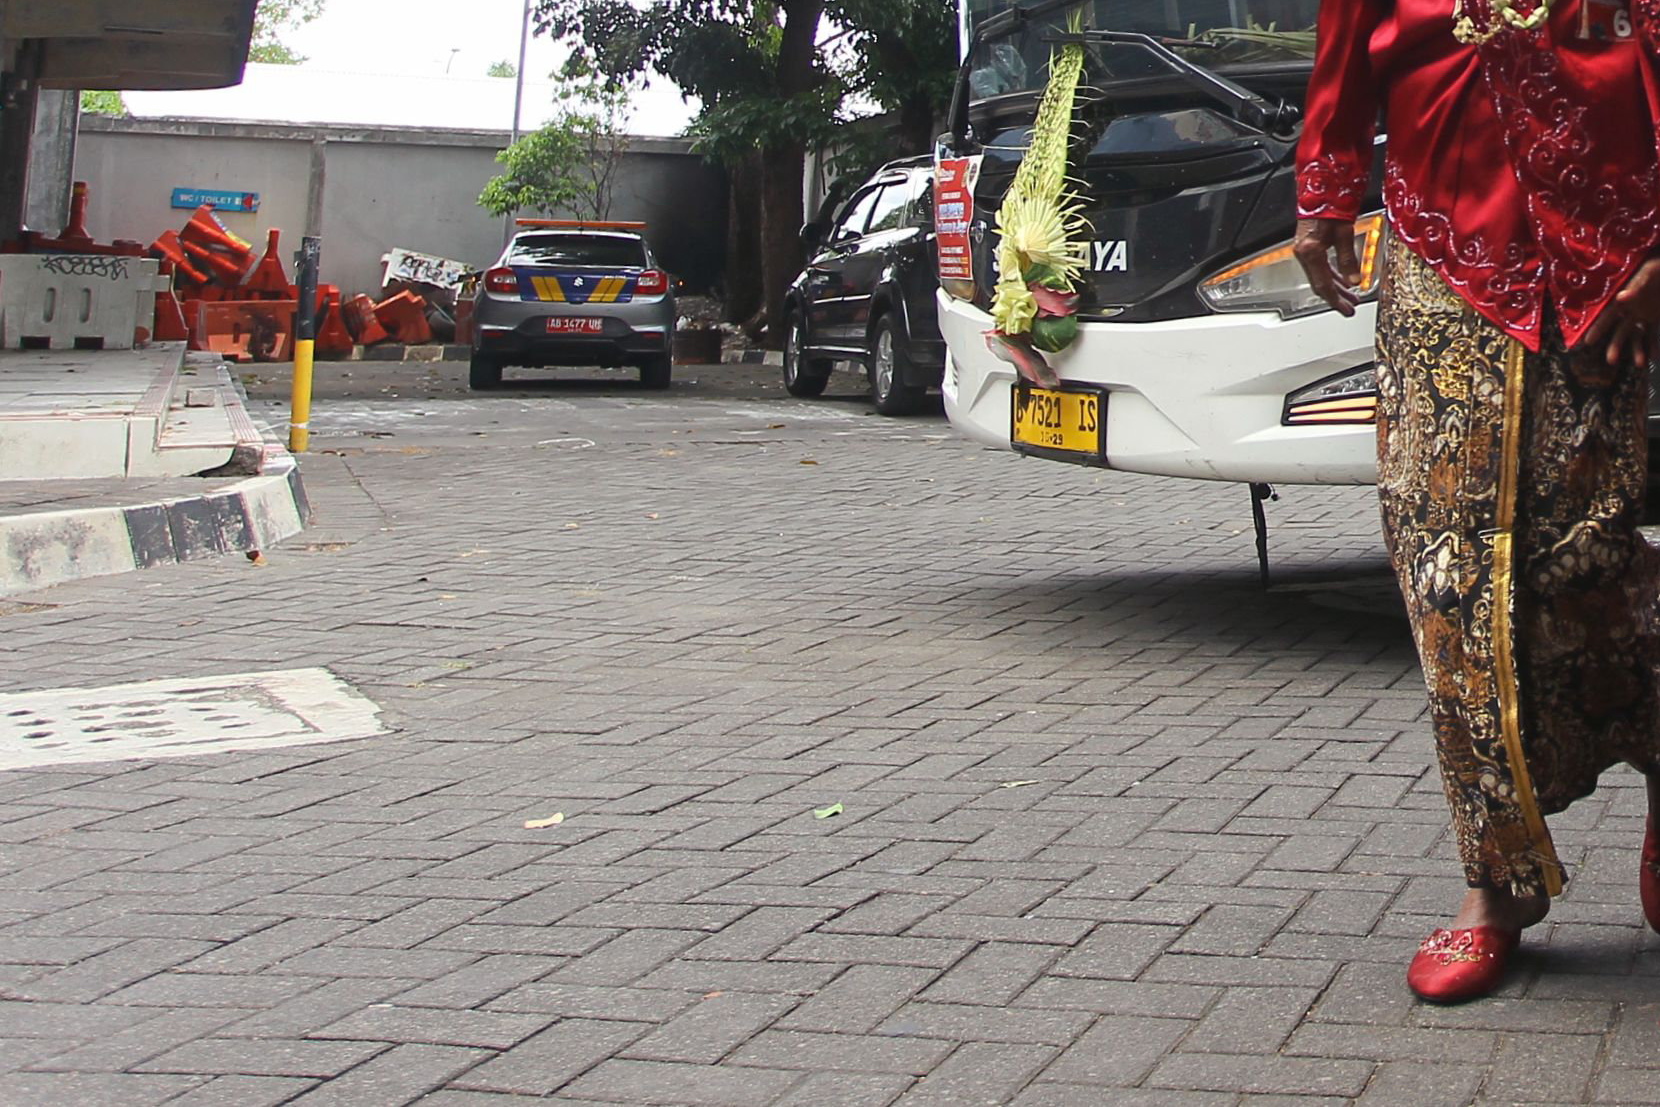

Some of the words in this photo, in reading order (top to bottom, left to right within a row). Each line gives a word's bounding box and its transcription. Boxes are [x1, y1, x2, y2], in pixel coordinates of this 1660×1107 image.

[1612, 8, 1632, 38] 6
[199, 195, 232, 204] TOILET
[1029, 393, 1062, 429] 7521
[1078, 398, 1097, 433] IS
